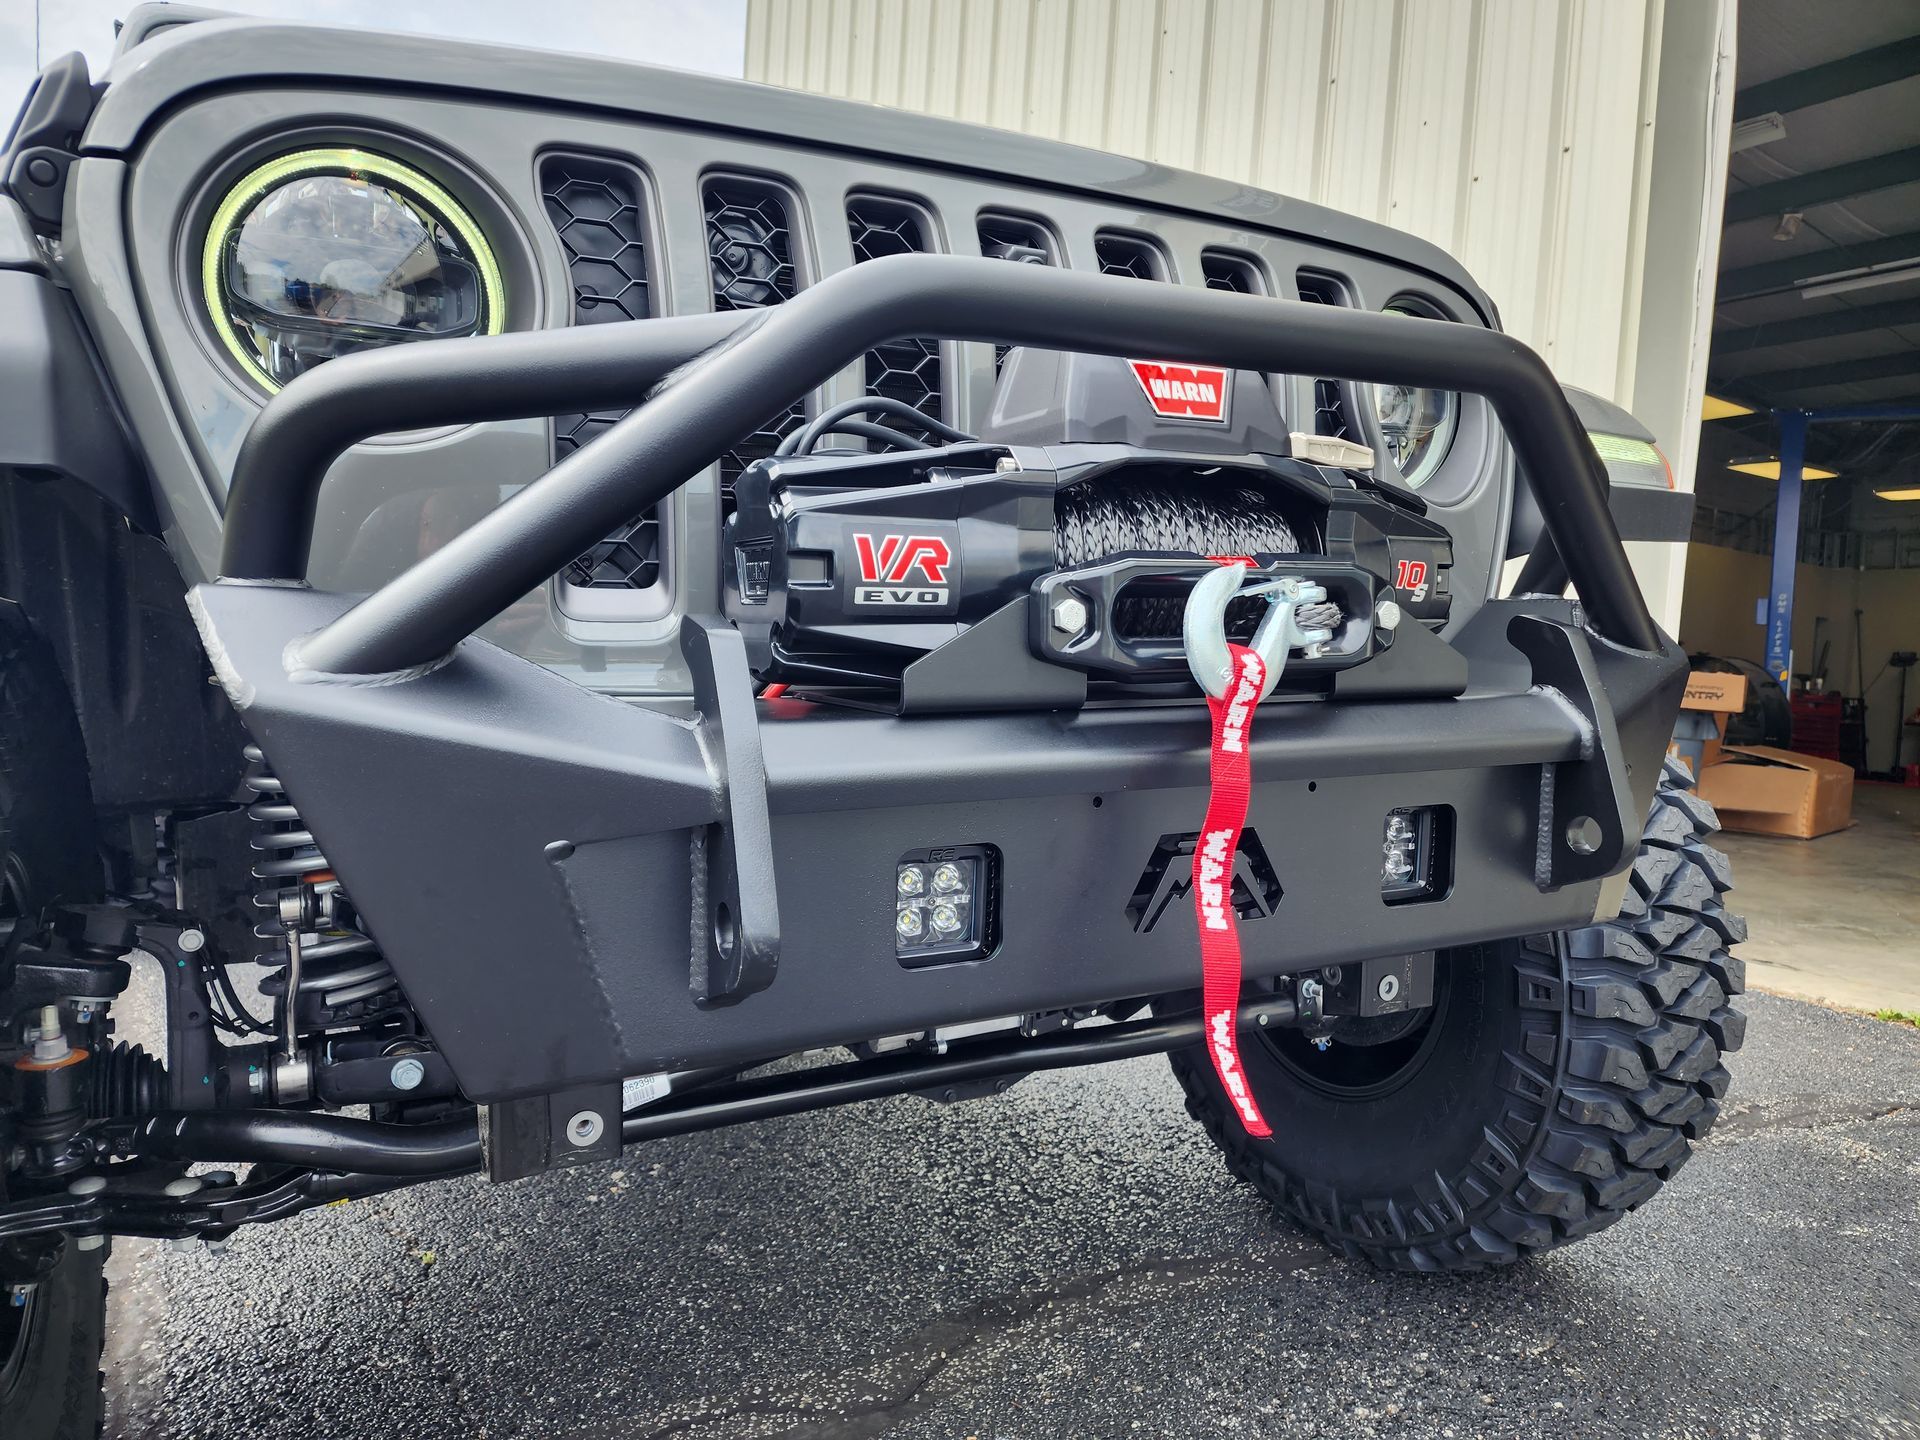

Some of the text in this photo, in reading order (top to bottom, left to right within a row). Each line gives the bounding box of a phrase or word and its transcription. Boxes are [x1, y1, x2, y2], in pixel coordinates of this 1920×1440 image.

[1149, 378, 1217, 403] WARN
[852, 533, 952, 584] VR
[1395, 559, 1427, 590] 10
[863, 590, 940, 603] EVO
[1221, 653, 1263, 753] WARN
[1200, 828, 1234, 930] WARN
[1211, 1010, 1258, 1122] WARN
